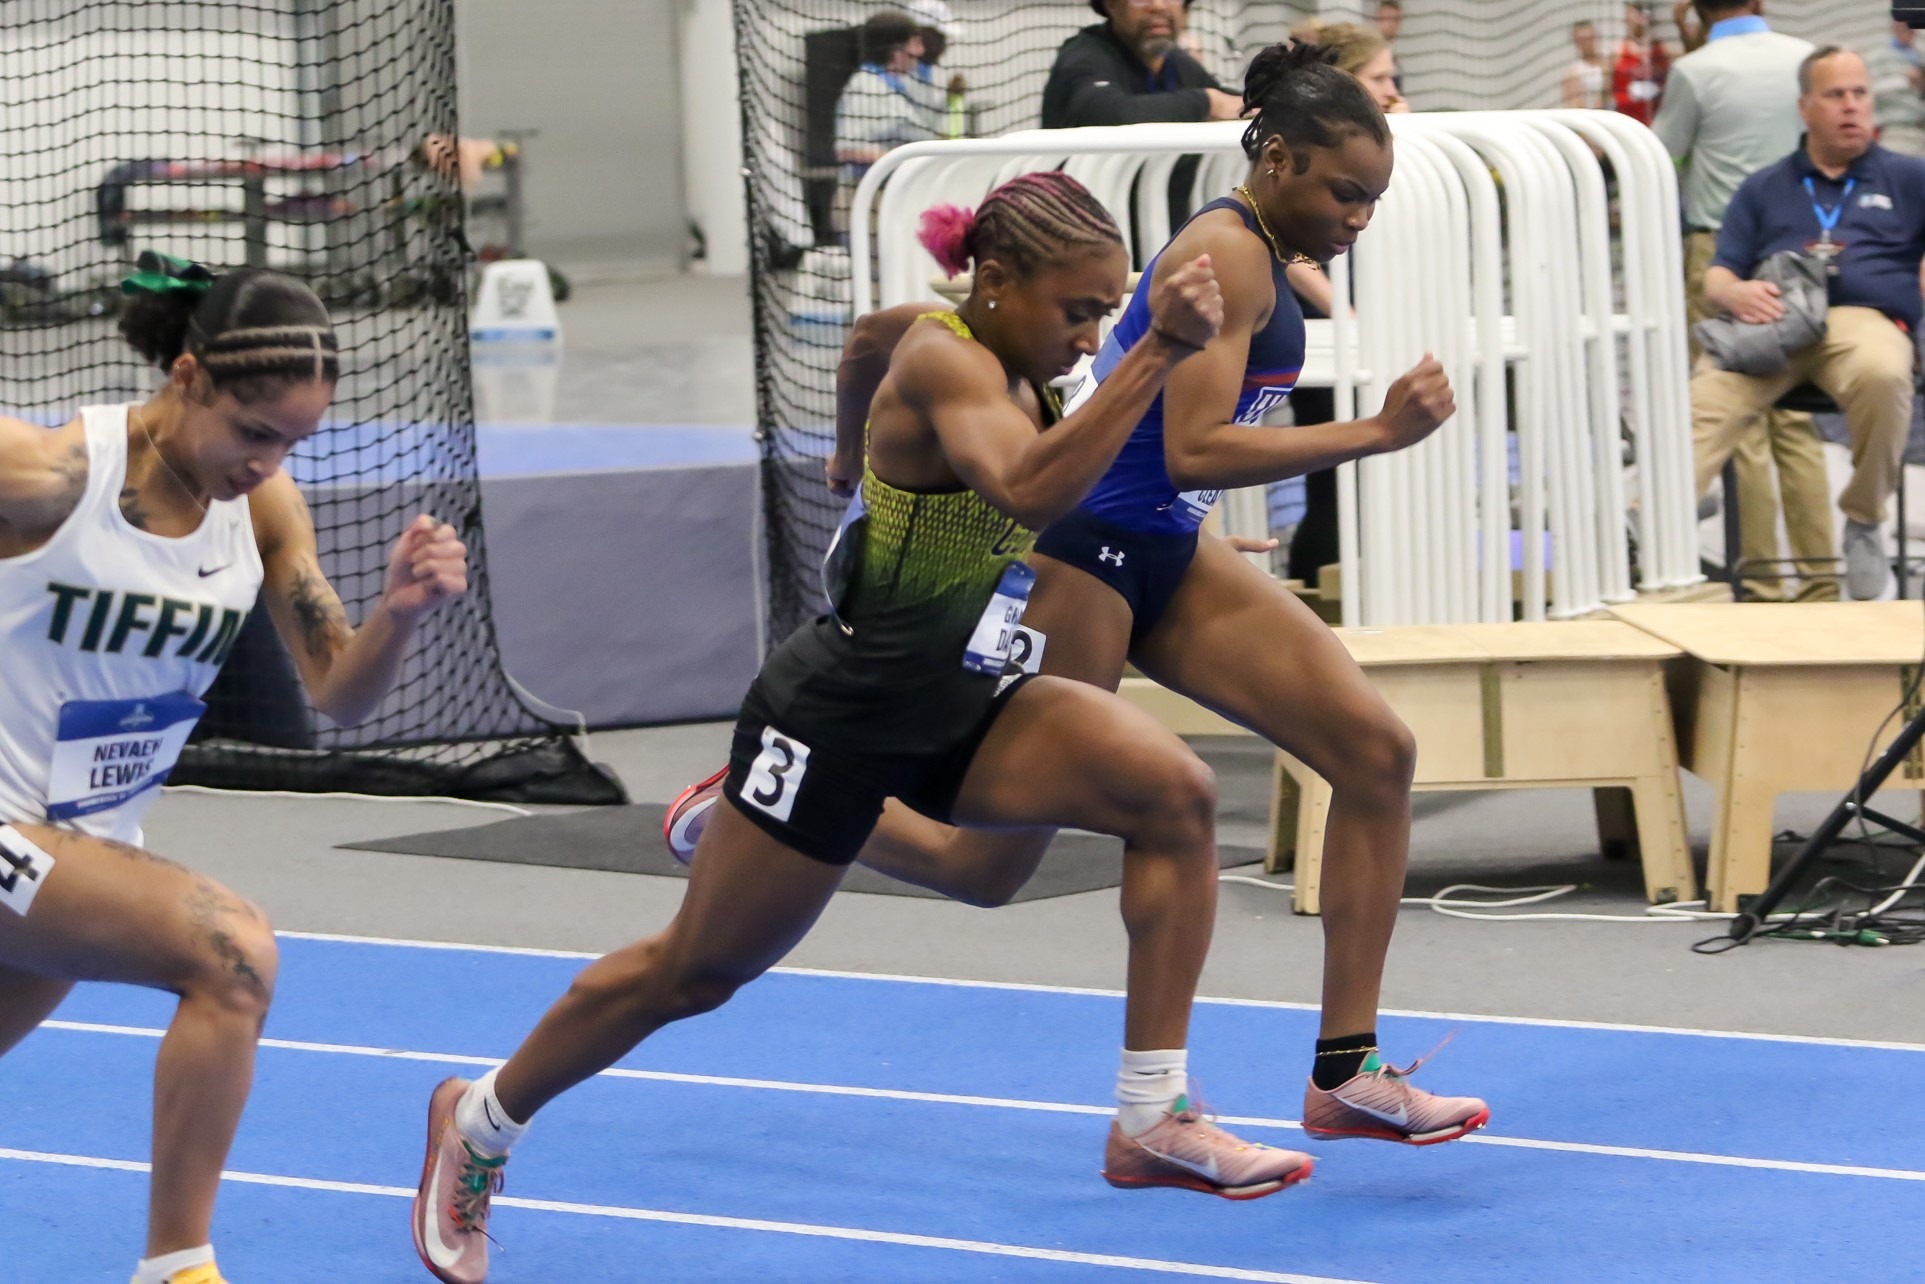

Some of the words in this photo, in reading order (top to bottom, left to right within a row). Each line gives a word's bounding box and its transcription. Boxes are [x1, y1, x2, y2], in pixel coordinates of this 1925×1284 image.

[90, 759, 154, 790] LEWIS
[752, 737, 795, 806] 3
[0, 842, 40, 894] 4
